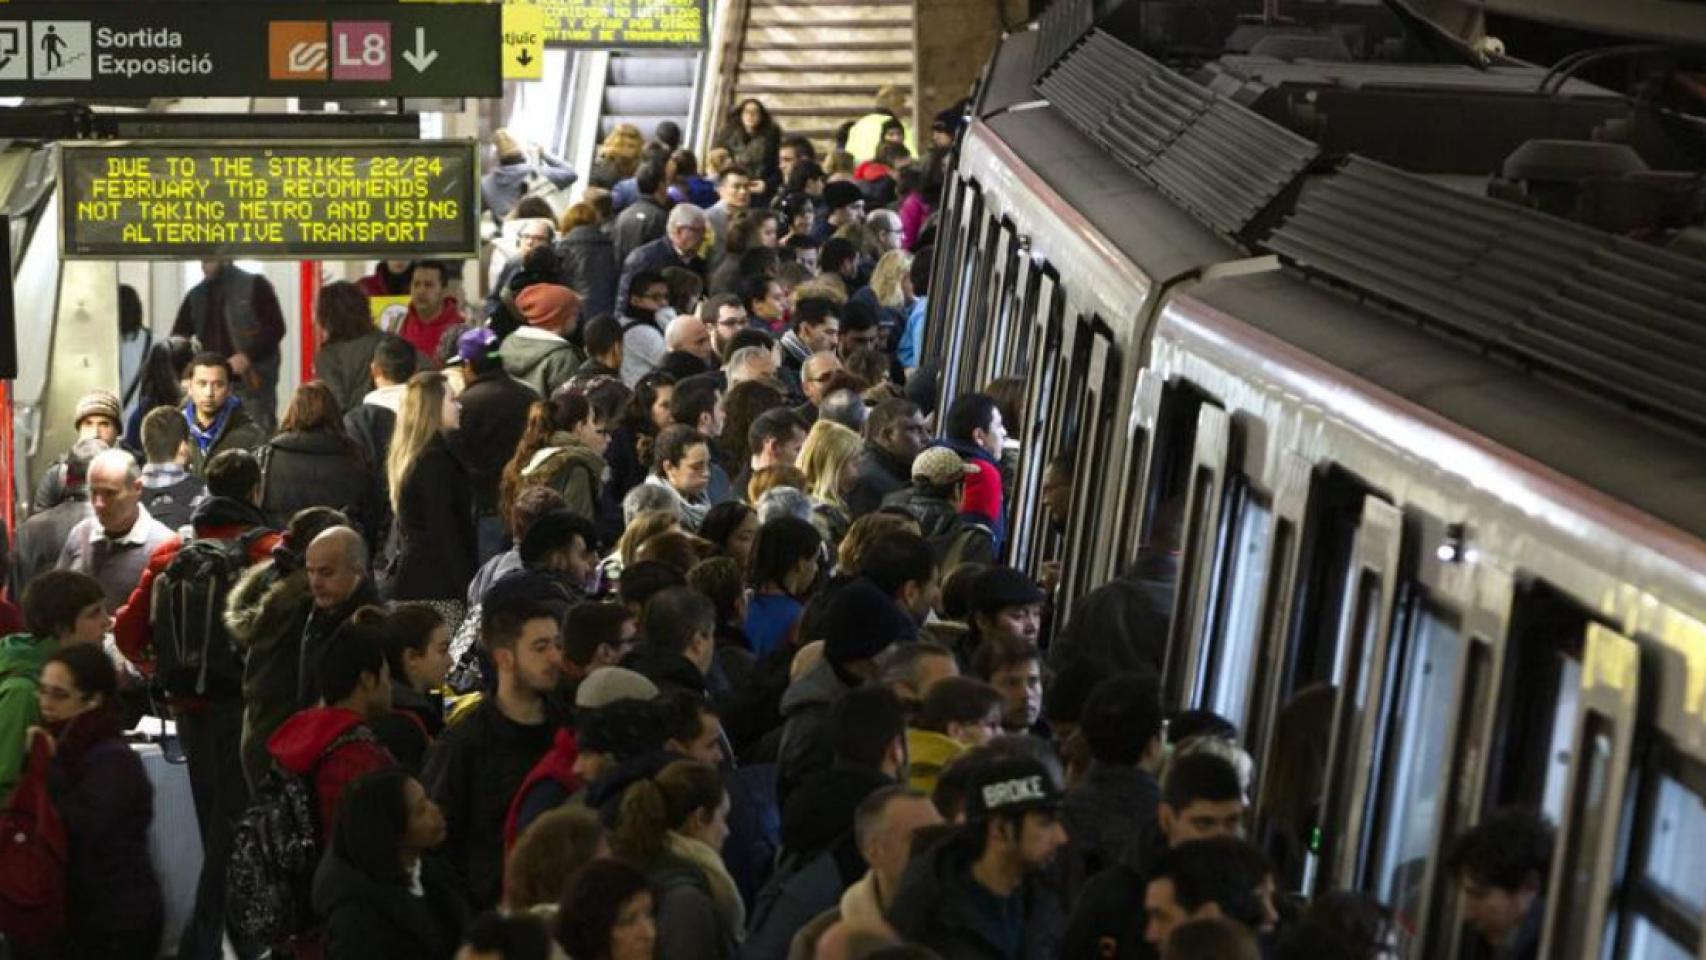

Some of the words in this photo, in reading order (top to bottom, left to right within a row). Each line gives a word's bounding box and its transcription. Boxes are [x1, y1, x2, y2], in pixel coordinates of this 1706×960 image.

[97, 27, 182, 48] Sortida
[339, 34, 386, 66] L8
[98, 53, 213, 78] Exposició
[107, 157, 149, 178] DUE
[166, 157, 196, 177] TO
[212, 157, 254, 177] THE
[269, 157, 355, 177] STRIKE
[369, 156, 443, 177] 22/24
[92, 179, 210, 199] FEBRUARY
[225, 179, 268, 198] TMB
[282, 178, 429, 198] RECOMMENDS
[78, 200, 119, 221] NOT
[140, 200, 224, 221] TAKING
[240, 200, 312, 221] METRO
[327, 200, 372, 220] AND
[385, 200, 457, 220] USING
[123, 222, 283, 243] ALTERNATIVE
[300, 222, 428, 242] TRANSPORT
[983, 775, 1045, 808] BROKE
